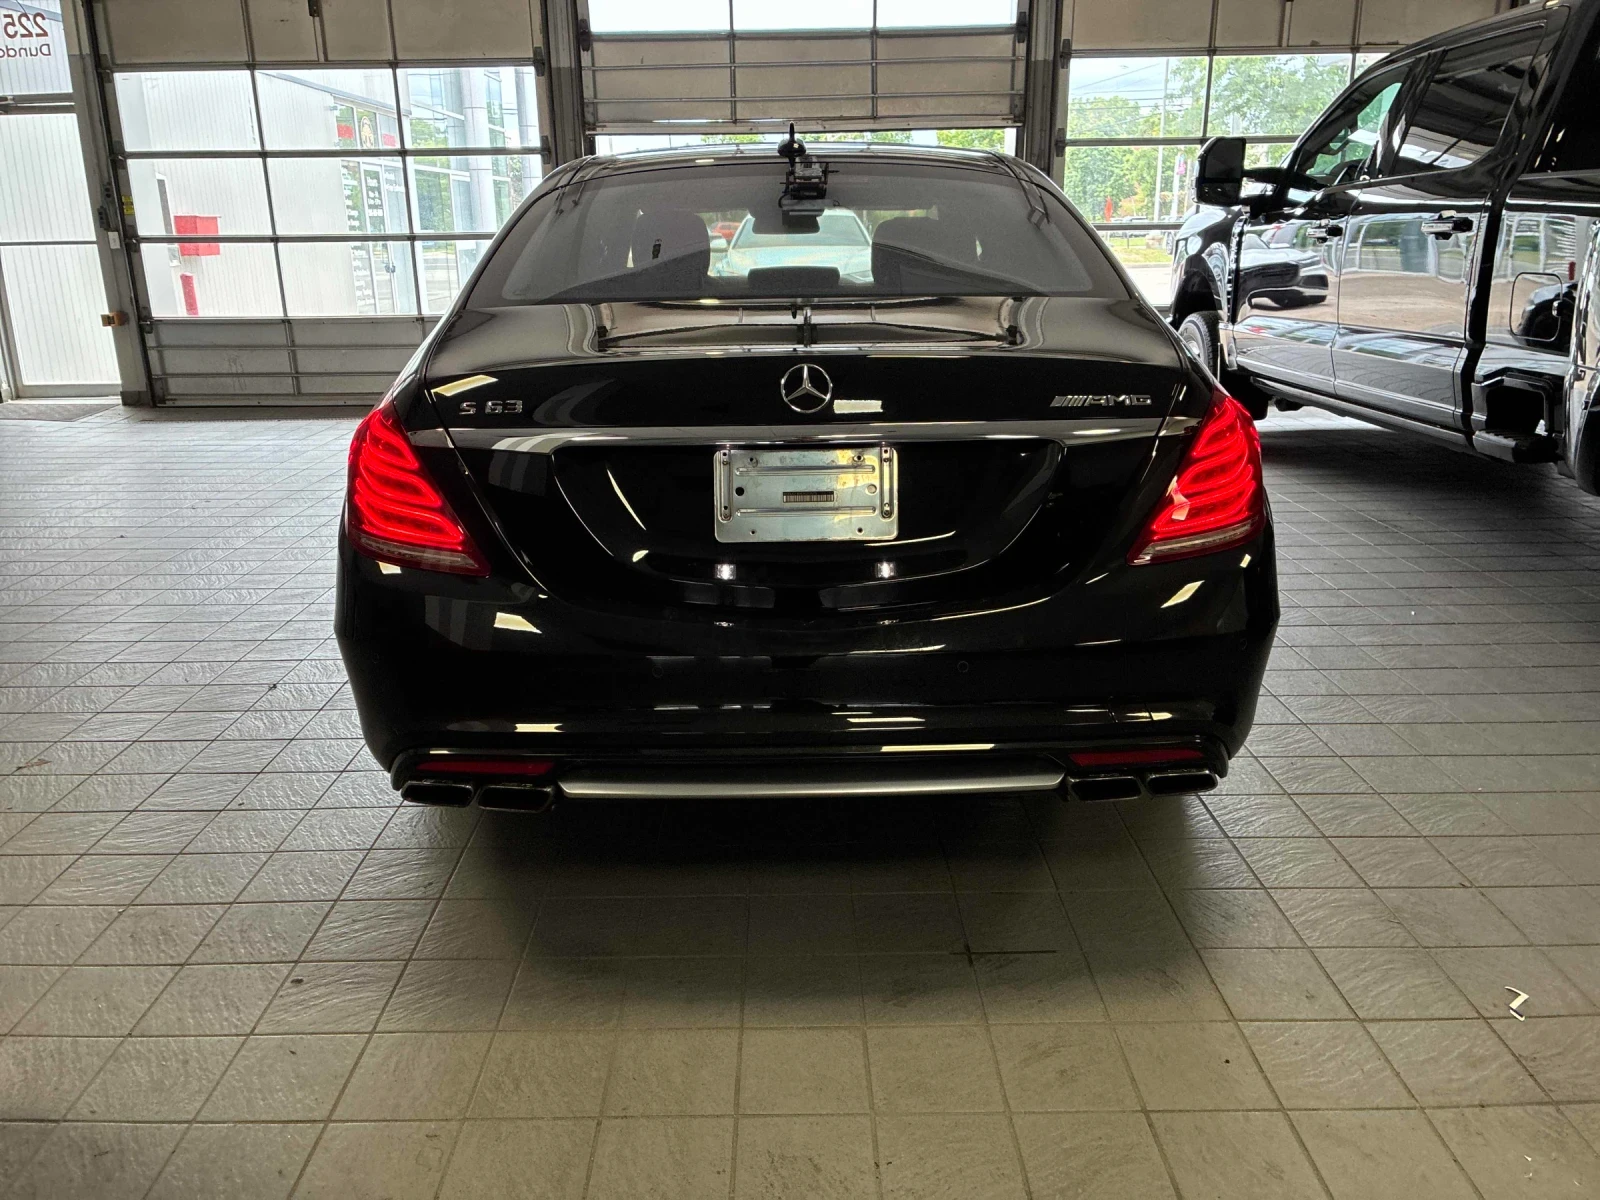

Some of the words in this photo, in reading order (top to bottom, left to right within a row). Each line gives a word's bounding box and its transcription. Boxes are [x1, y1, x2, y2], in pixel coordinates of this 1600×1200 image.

[459, 401, 477, 415] S
[485, 400, 522, 414] 63
[1082, 395, 1152, 407] AMG
